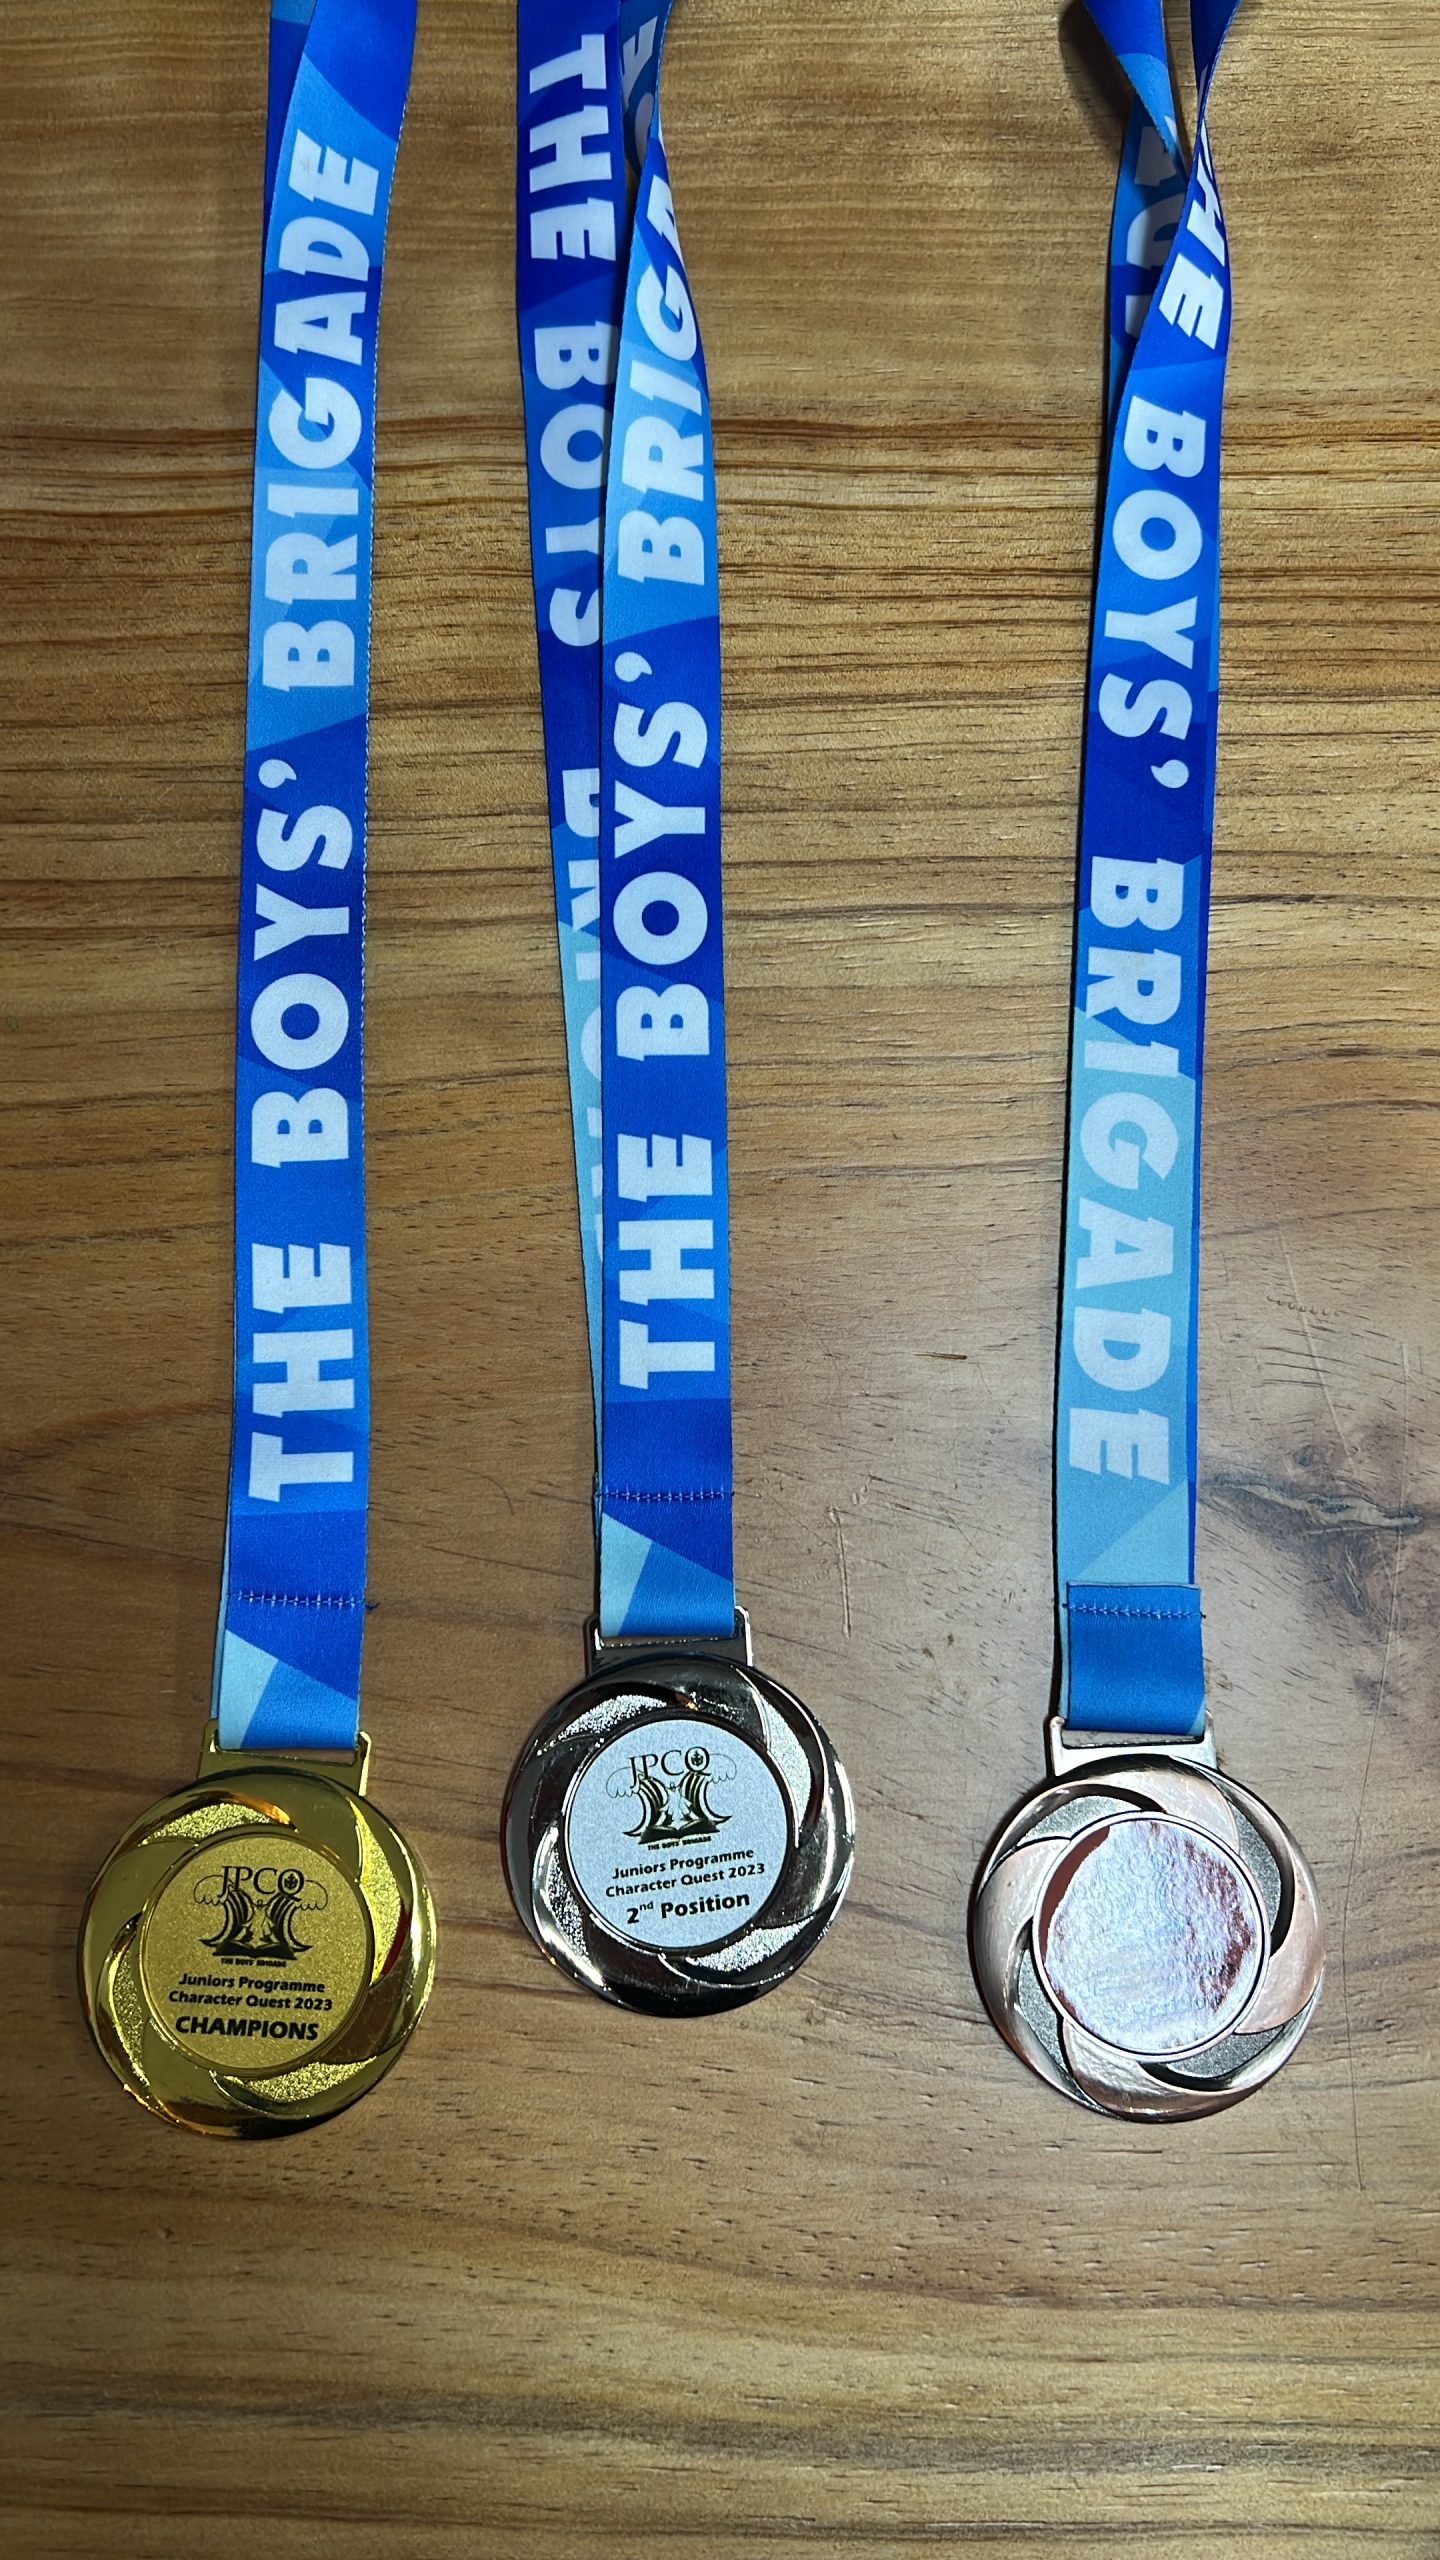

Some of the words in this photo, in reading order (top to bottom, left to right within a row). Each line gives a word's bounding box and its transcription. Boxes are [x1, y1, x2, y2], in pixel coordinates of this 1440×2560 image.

[530, 34, 616, 261] THE
[262, 128, 379, 692] BRIGADE
[534, 320, 620, 648] BOYS
[1098, 395, 1207, 789] BOYS'
[613, 651, 709, 1062] BOYS'
[251, 759, 353, 1169] BOYS'
[1069, 856, 1184, 1485] BRIGADE
[618, 1133, 715, 1390] THE
[249, 1242, 354, 1502] THE
[628, 1746, 712, 1789] JPCQ
[218, 1865, 305, 1902] JPCQ
[605, 1879, 677, 1898] Character
[680, 1870, 725, 1886] Quest
[728, 1863, 765, 1879] 2023
[612, 1863, 666, 1880] Juniors
[669, 1849, 754, 1871] Programme
[626, 1901, 654, 1924] 2nd
[660, 1893, 750, 1918] Position
[648, 1843, 660, 1851] THE
[168, 1991, 242, 2006] Character
[246, 1994, 291, 2009] Quest
[293, 1997, 333, 2011] 2023
[175, 2016, 319, 2041] CHAMPIONS
[178, 1973, 235, 1988] Juniors
[238, 1976, 326, 1993] Programme
